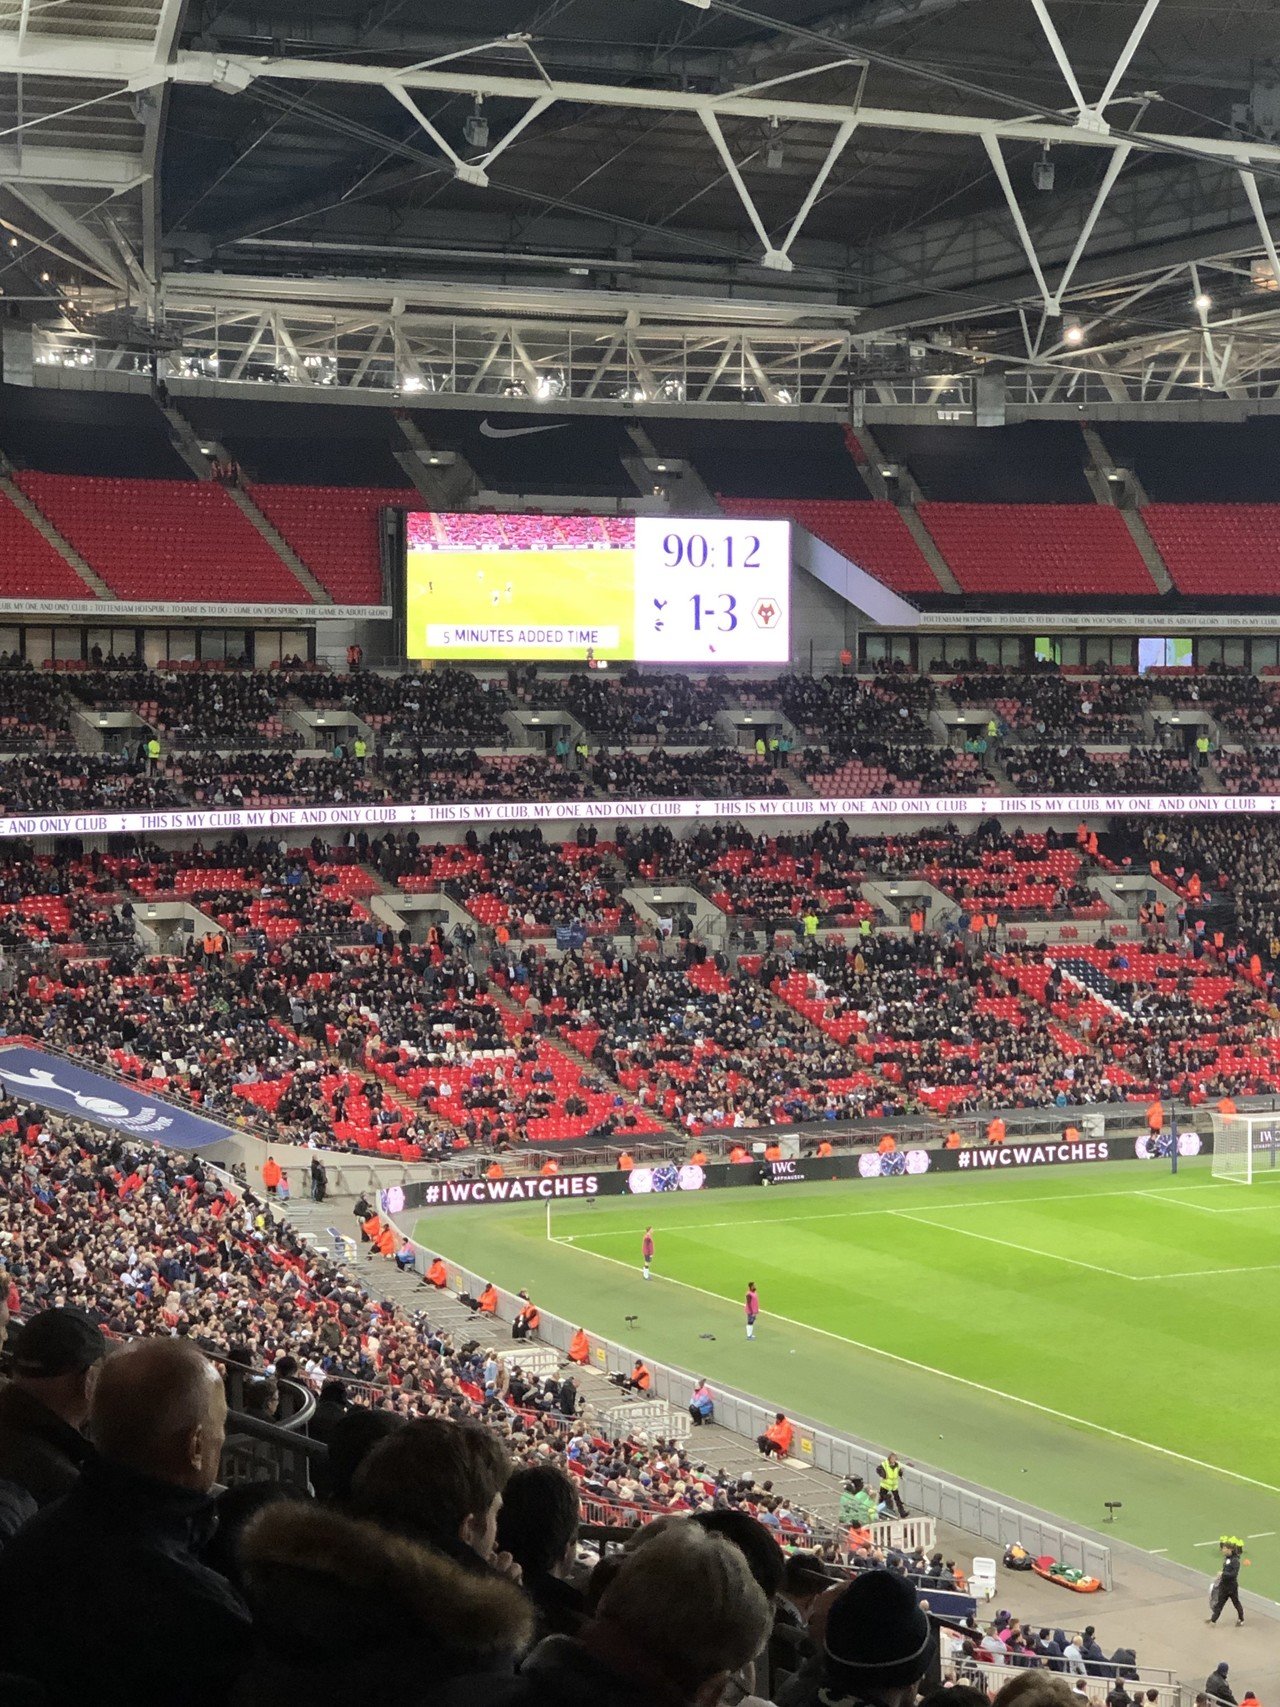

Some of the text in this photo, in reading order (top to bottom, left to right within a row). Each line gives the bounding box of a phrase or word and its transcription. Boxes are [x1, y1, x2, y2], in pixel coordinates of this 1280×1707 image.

[663, 533, 761, 568] 90:12
[95, 604, 134, 612] TOTTENHAM
[264, 607, 278, 615] YOU
[278, 607, 299, 615] SPURS
[318, 608, 336, 616] GAME
[689, 593, 738, 632] 1-3
[443, 629, 599, 643] 5 MINUTES ADDED TIME
[9, 820, 36, 833] AND
[40, 818, 70, 832] ONLY
[75, 817, 107, 831] CLUB
[140, 815, 168, 828] THIS
[171, 815, 182, 828] IS
[186, 814, 206, 827] MY
[247, 812, 266, 825] MY
[270, 811, 296, 824] ONE
[300, 810, 327, 823] AND
[331, 809, 360, 822] ONLY
[365, 809, 397, 821] CLUB
[429, 807, 456, 819] THIS
[459, 807, 470, 818] IS
[474, 806, 492, 818] MY
[534, 805, 552, 817] MY
[556, 804, 580, 816] ONE
[586, 804, 612, 816] AND
[615, 804, 646, 815] ONLY
[650, 803, 681, 815] CLUB
[715, 803, 742, 814] THIS
[745, 802, 756, 813] IS
[760, 802, 777, 813] MY
[819, 801, 838, 812] MY
[842, 801, 866, 812] ONE
[871, 801, 898, 812] AND
[901, 800, 931, 811] ONLY
[936, 800, 967, 811] CLUB
[1000, 799, 1027, 811] THIS
[1030, 799, 1042, 811] IS
[1045, 799, 1064, 810] MY
[1105, 799, 1124, 810] MY
[1128, 799, 1152, 810] ONE
[1158, 799, 1185, 810] AND
[1188, 799, 1219, 810] ONLY
[1224, 798, 1256, 810] CLUB
[772, 1161, 797, 1174] IWC
[957, 1143, 1109, 1168] #IWCWATCHES
[426, 1177, 598, 1203] #IWCWATCHES
